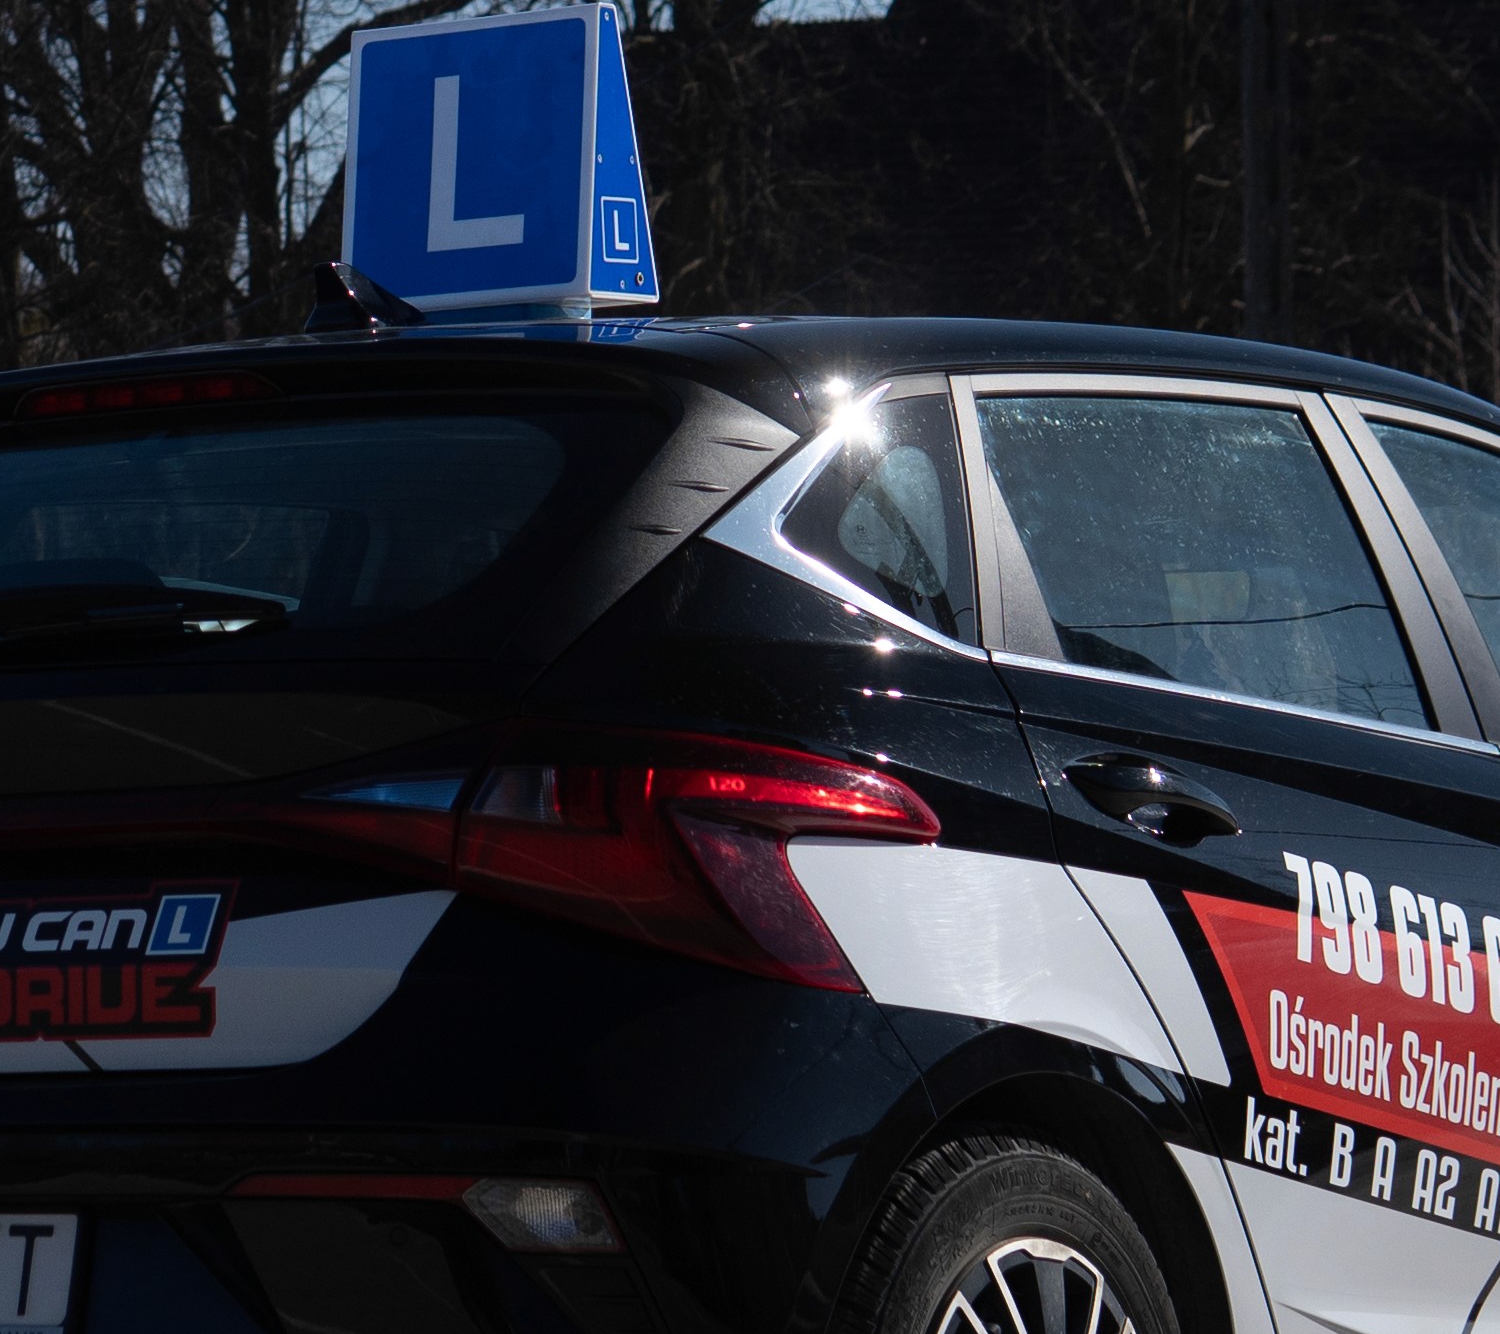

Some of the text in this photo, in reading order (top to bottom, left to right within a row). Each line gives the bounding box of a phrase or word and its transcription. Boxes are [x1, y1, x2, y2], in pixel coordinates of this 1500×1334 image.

[427, 74, 525, 252] L
[612, 209, 630, 251] L
[22, 908, 148, 953] CAN
[166, 905, 192, 945] L
[1282, 851, 1384, 985] 798
[1389, 885, 1475, 1015] 613
[1269, 988, 1394, 1103] Ośrodek
[1244, 1095, 1308, 1177] kat.
[1329, 1122, 1355, 1188] B
[1370, 1136, 1397, 1201] A
[1411, 1149, 1460, 1220] A2
